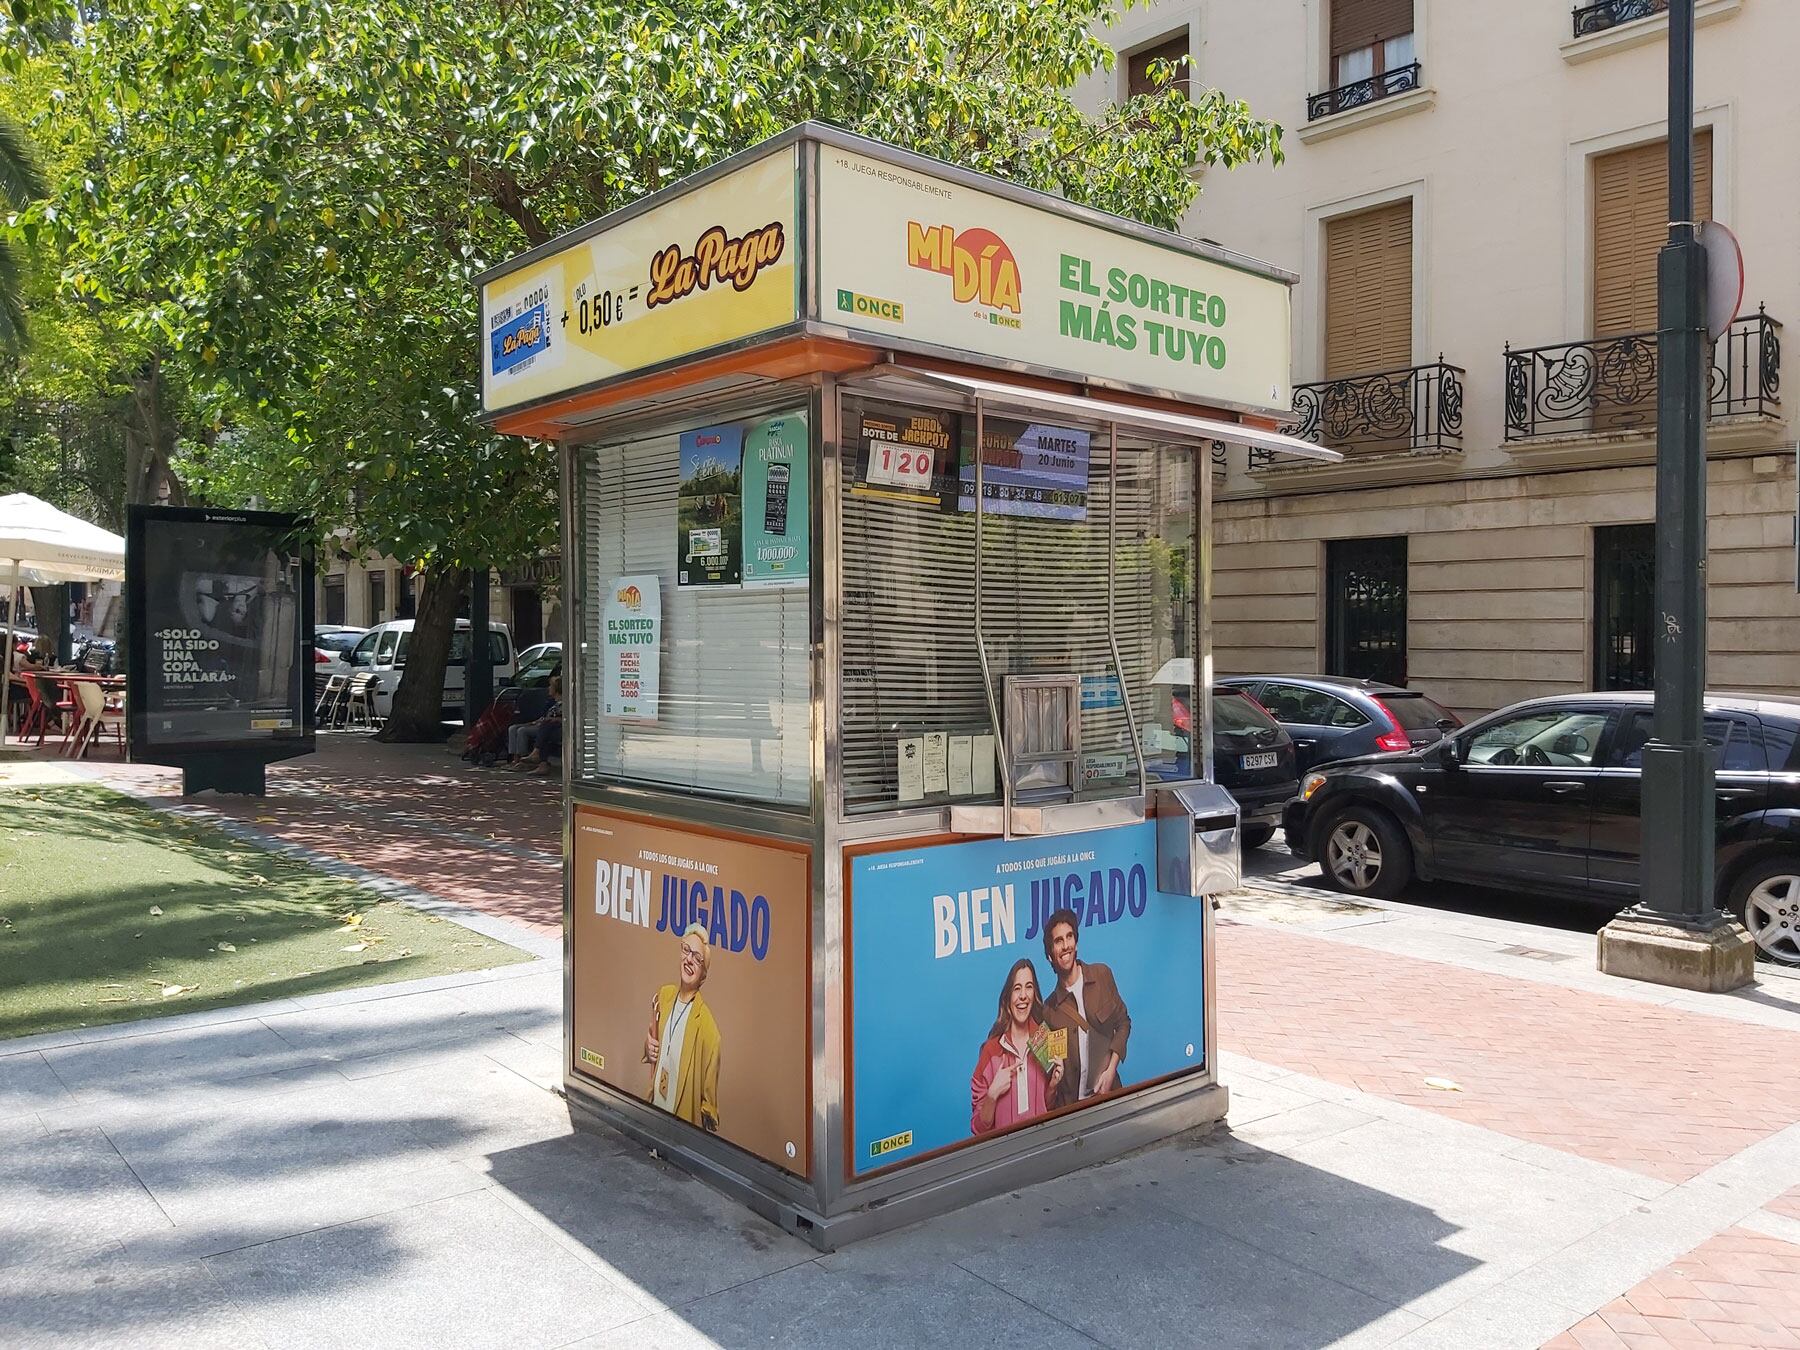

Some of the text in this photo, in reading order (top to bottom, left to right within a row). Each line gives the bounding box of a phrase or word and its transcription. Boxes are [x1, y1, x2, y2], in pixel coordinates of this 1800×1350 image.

[852, 163, 877, 178] JUEGA
[877, 170, 953, 200] RESPONSABLEMENTE
[907, 221, 955, 273] MI
[647, 221, 785, 309] La Paga
[952, 245, 1022, 314] DÍA
[1059, 253, 1227, 328] EL SORTEO
[579, 290, 612, 336] 0,50
[615, 294, 624, 322] €
[856, 297, 901, 320] ONCE
[998, 318, 1021, 329] ONCE
[1059, 300, 1227, 370] MÁS TUYO
[862, 427, 899, 441] BOTE DE
[1037, 436, 1077, 453] MARTES
[758, 445, 794, 462] PLATINUM
[1038, 454, 1075, 468] 20 Junio
[608, 619, 654, 631] EL SORTEO
[163, 640, 220, 650] HA SIDO
[608, 631, 653, 645] MÁS TUYO
[163, 650, 194, 661] UNA
[620, 680, 640, 690] GANA
[1245, 755, 1263, 767] 6297
[639, 850, 643, 859] A
[643, 850, 659, 862] TODOS
[658, 854, 668, 864] LOS
[667, 855, 677, 866] QUE
[694, 861, 699, 871] A
[699, 862, 706, 872] LA
[705, 864, 719, 875] ONCE
[996, 864, 1001, 874] A
[1001, 861, 1022, 873] TODOS
[1022, 859, 1034, 870] LOS
[1034, 857, 1046, 868] QUE
[1066, 854, 1071, 864] A
[1071, 853, 1079, 863] LA
[1079, 850, 1095, 862] ONCE
[595, 858, 770, 961] BIEN JUGADO
[932, 863, 1147, 959] BIEN JUGADO
[587, 1052, 603, 1067] ONCE
[882, 1134, 910, 1150] ONCE
